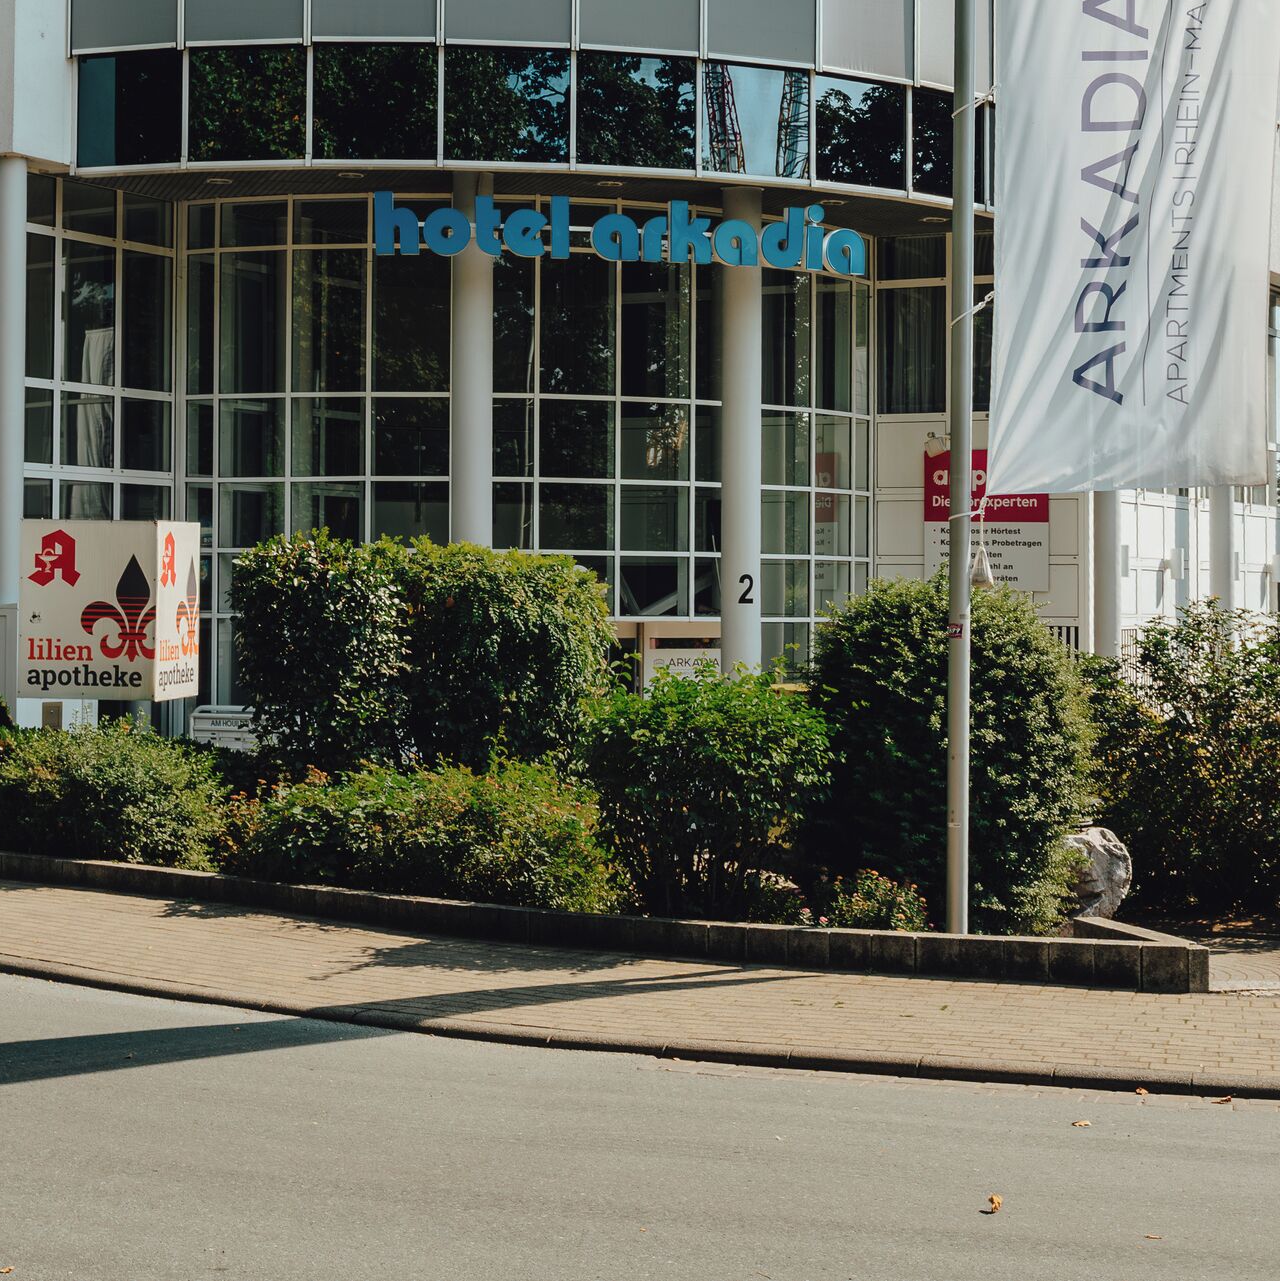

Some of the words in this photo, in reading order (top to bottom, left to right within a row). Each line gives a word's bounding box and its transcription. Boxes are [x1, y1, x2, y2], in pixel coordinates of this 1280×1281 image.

[374, 190, 570, 259] hotel
[590, 199, 866, 276] arkadia
[1165, 188, 1196, 406] APARTMENTS
[990, 527, 1021, 535] Hörtest
[991, 539, 1043, 549] Probetragen
[737, 573, 754, 604] 2
[27, 637, 94, 662] lilien
[159, 639, 181, 662] lilien
[27, 664, 143, 691] apotheke
[158, 662, 195, 692] apotheke
